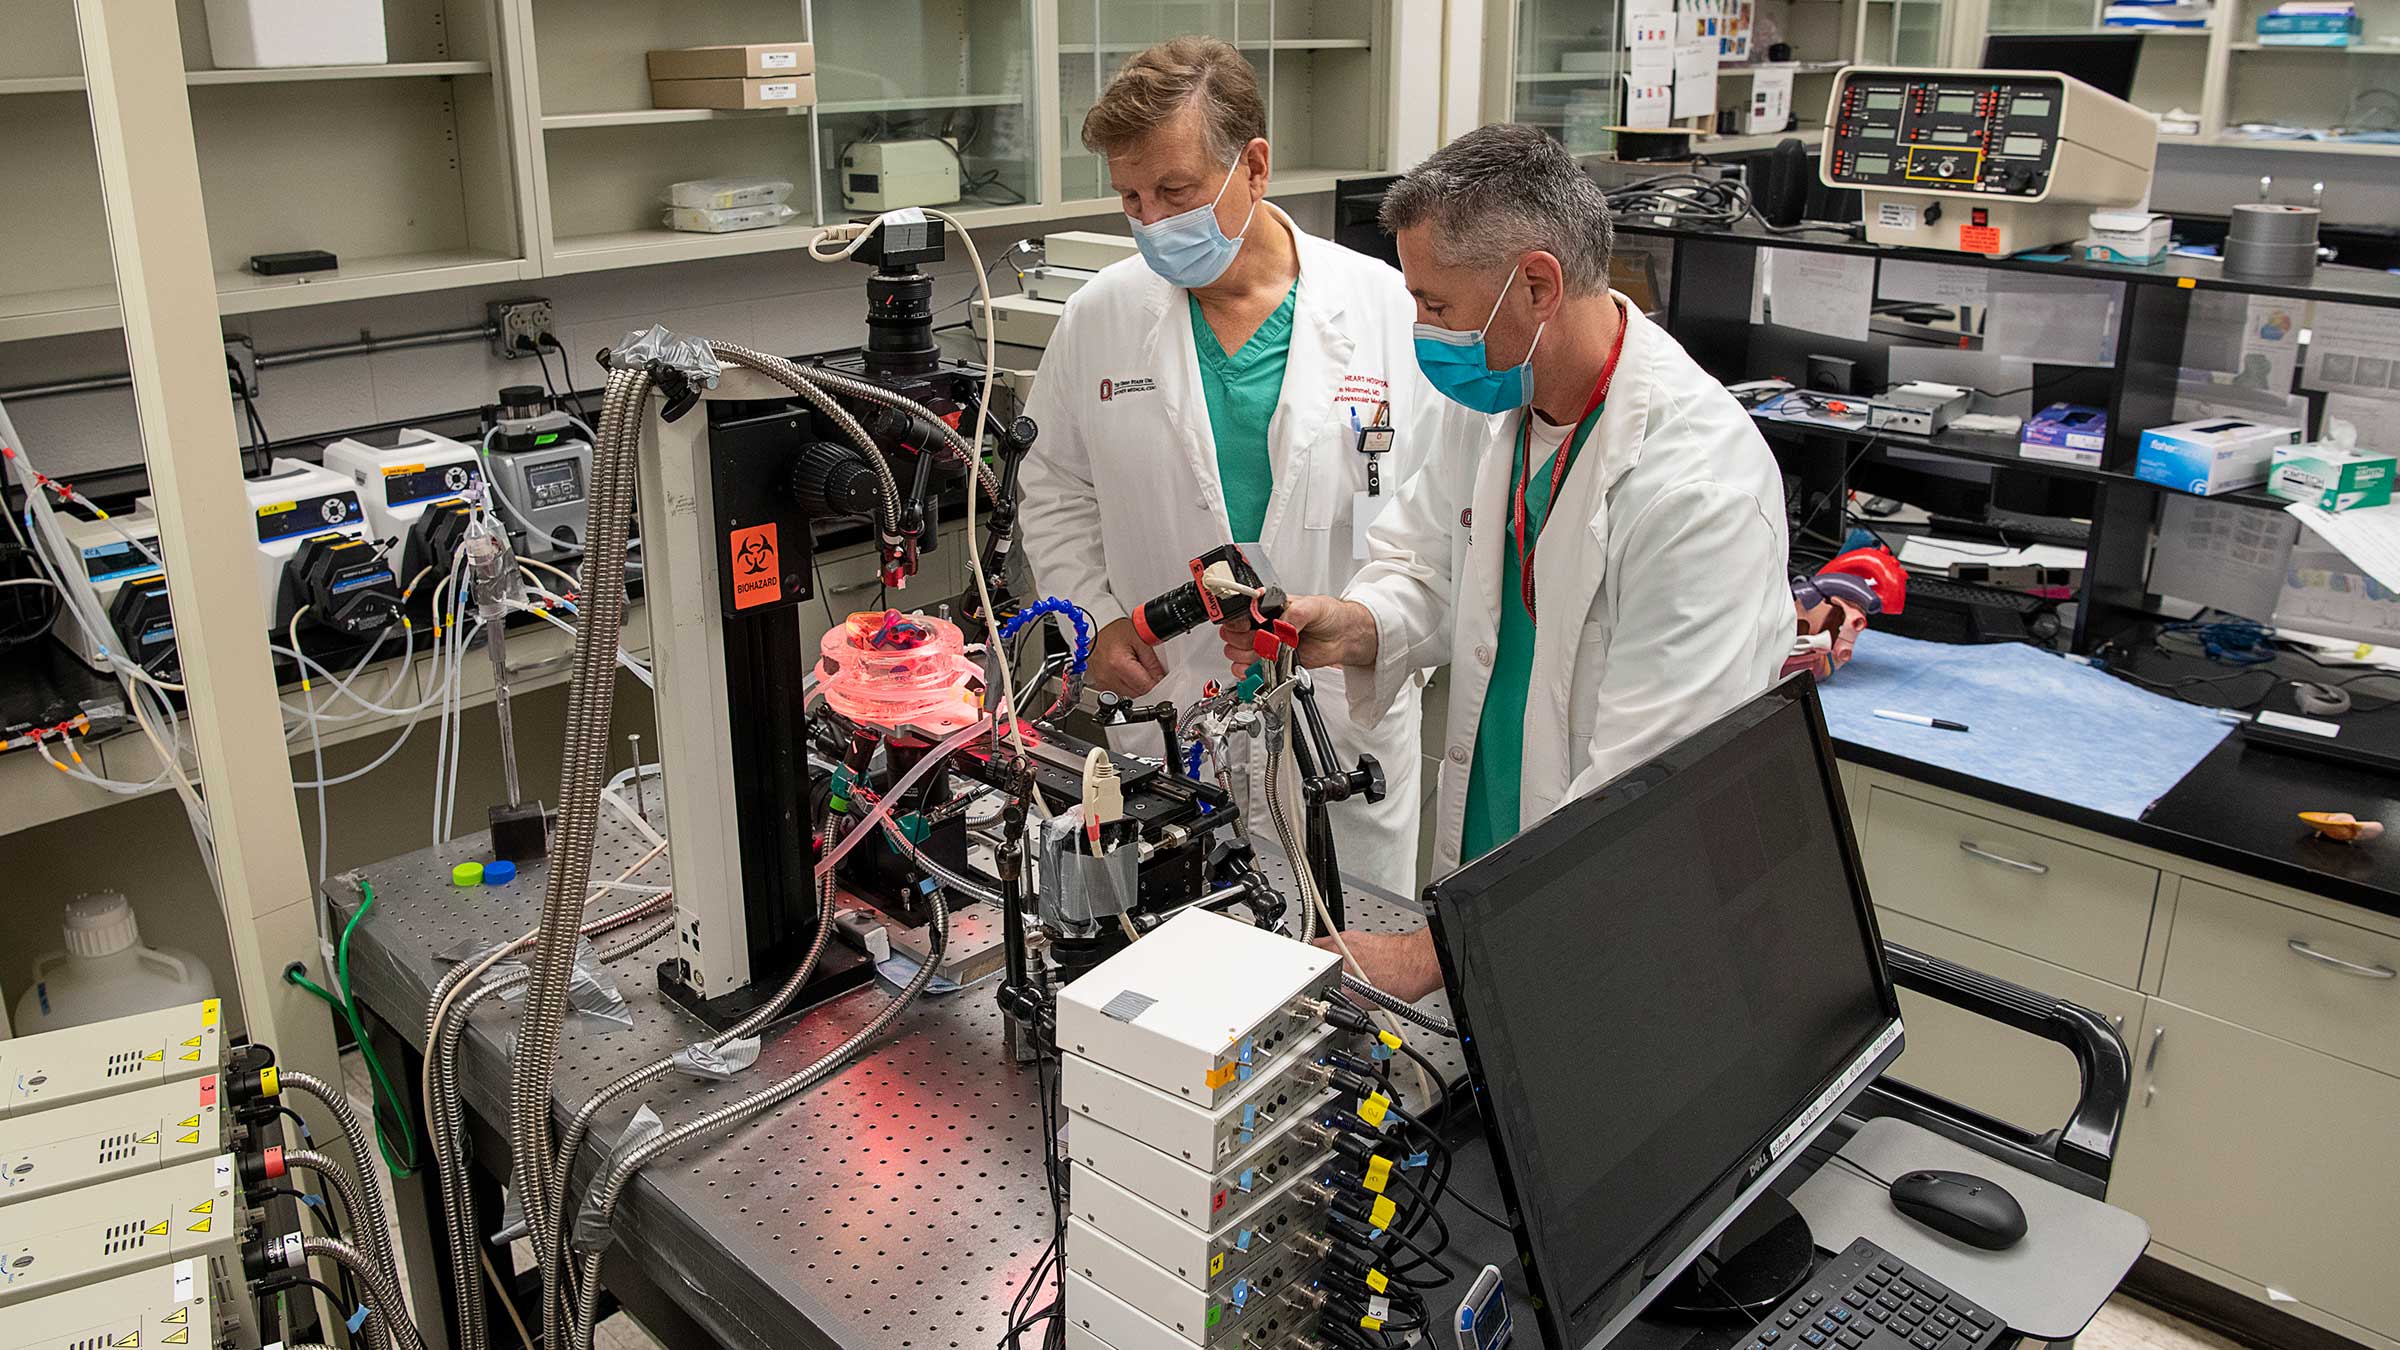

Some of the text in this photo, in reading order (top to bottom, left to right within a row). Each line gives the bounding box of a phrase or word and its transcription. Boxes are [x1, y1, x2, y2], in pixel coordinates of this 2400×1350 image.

[1344, 374, 1388, 388] HEART HOSPITA
[84, 547, 102, 557] RCA
[737, 576, 778, 595] BIOHAZARD
[1749, 1153, 1769, 1177] DELL
